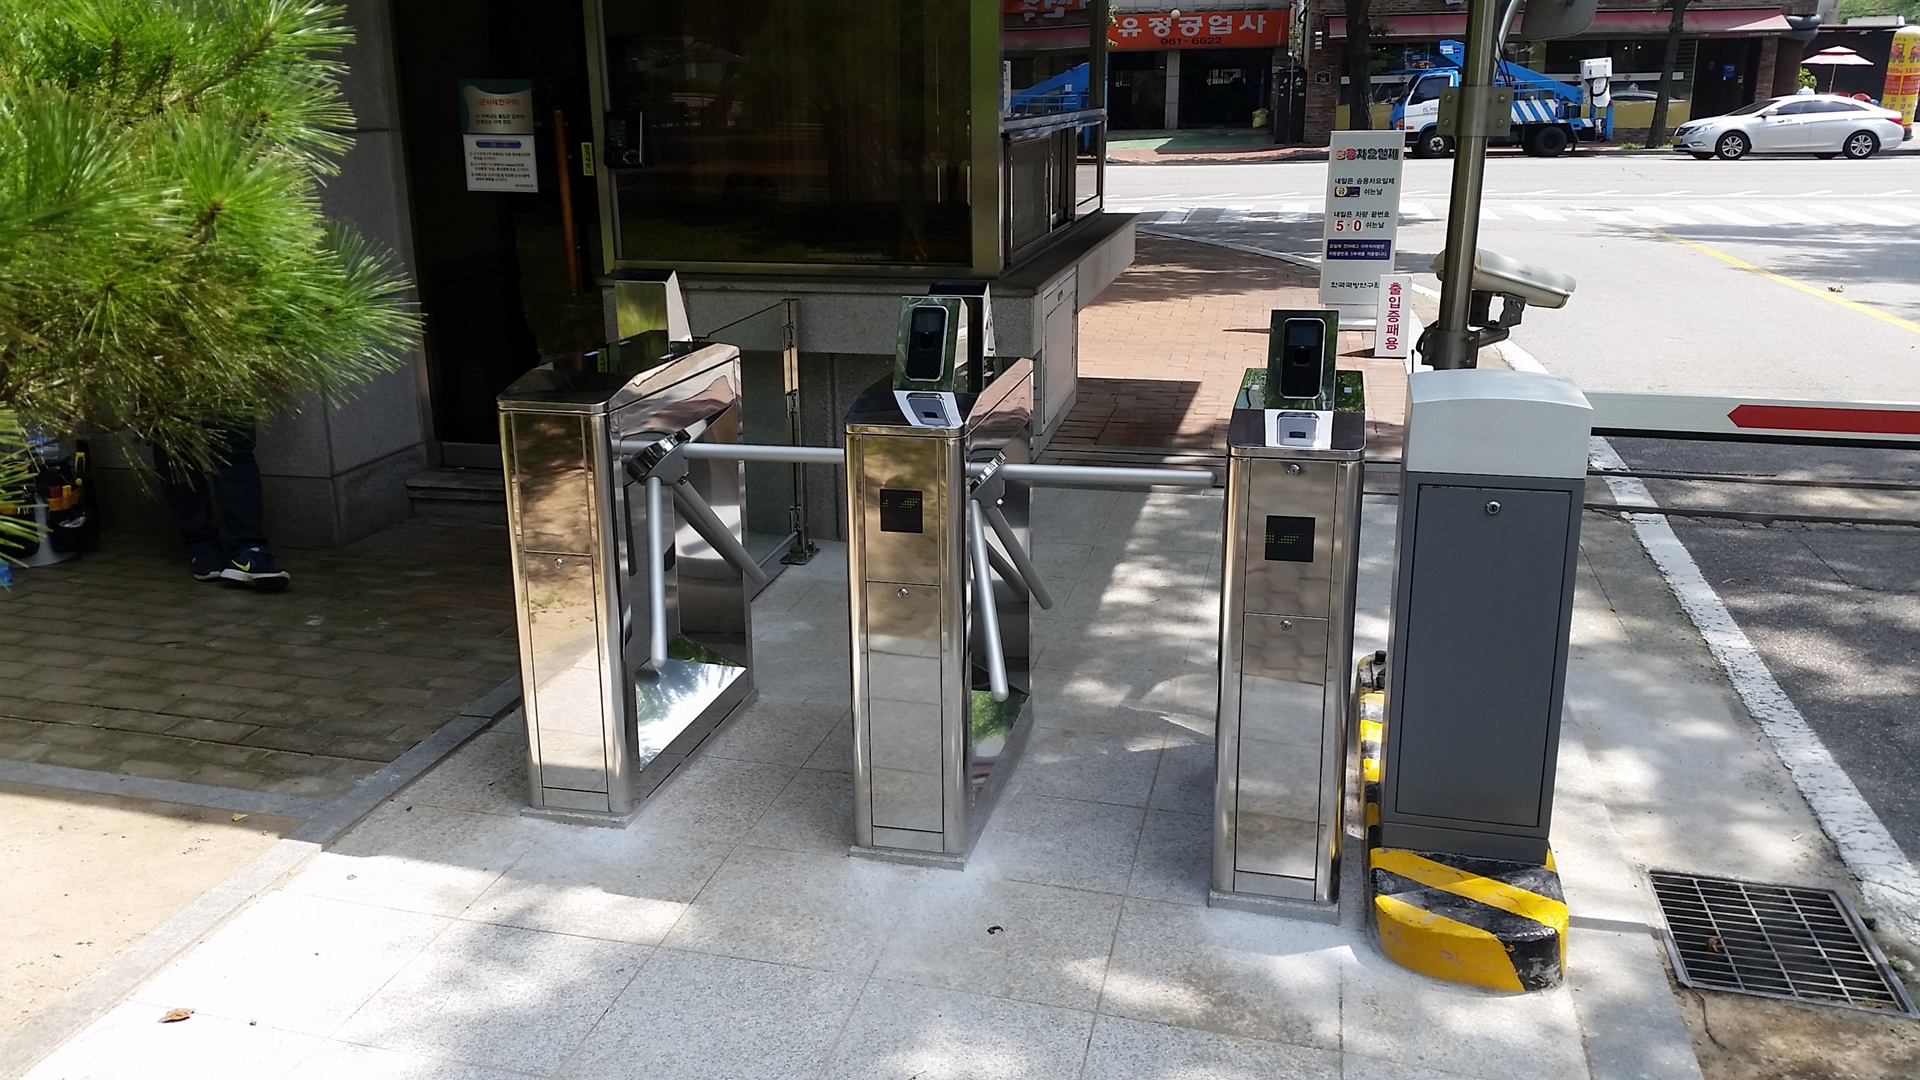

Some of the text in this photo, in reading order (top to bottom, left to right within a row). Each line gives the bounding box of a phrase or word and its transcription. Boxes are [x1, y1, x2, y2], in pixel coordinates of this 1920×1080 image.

[1118, 14, 1267, 38] 유정공업사
[1160, 36, 1222, 46] 961-6622
[1335, 177, 1395, 185] 내일은 승용차요일제
[1363, 188, 1383, 196] 쉬는날
[1336, 220, 1385, 231] 5 0 쉬는날
[1385, 282, 1403, 351] 출입증패용
